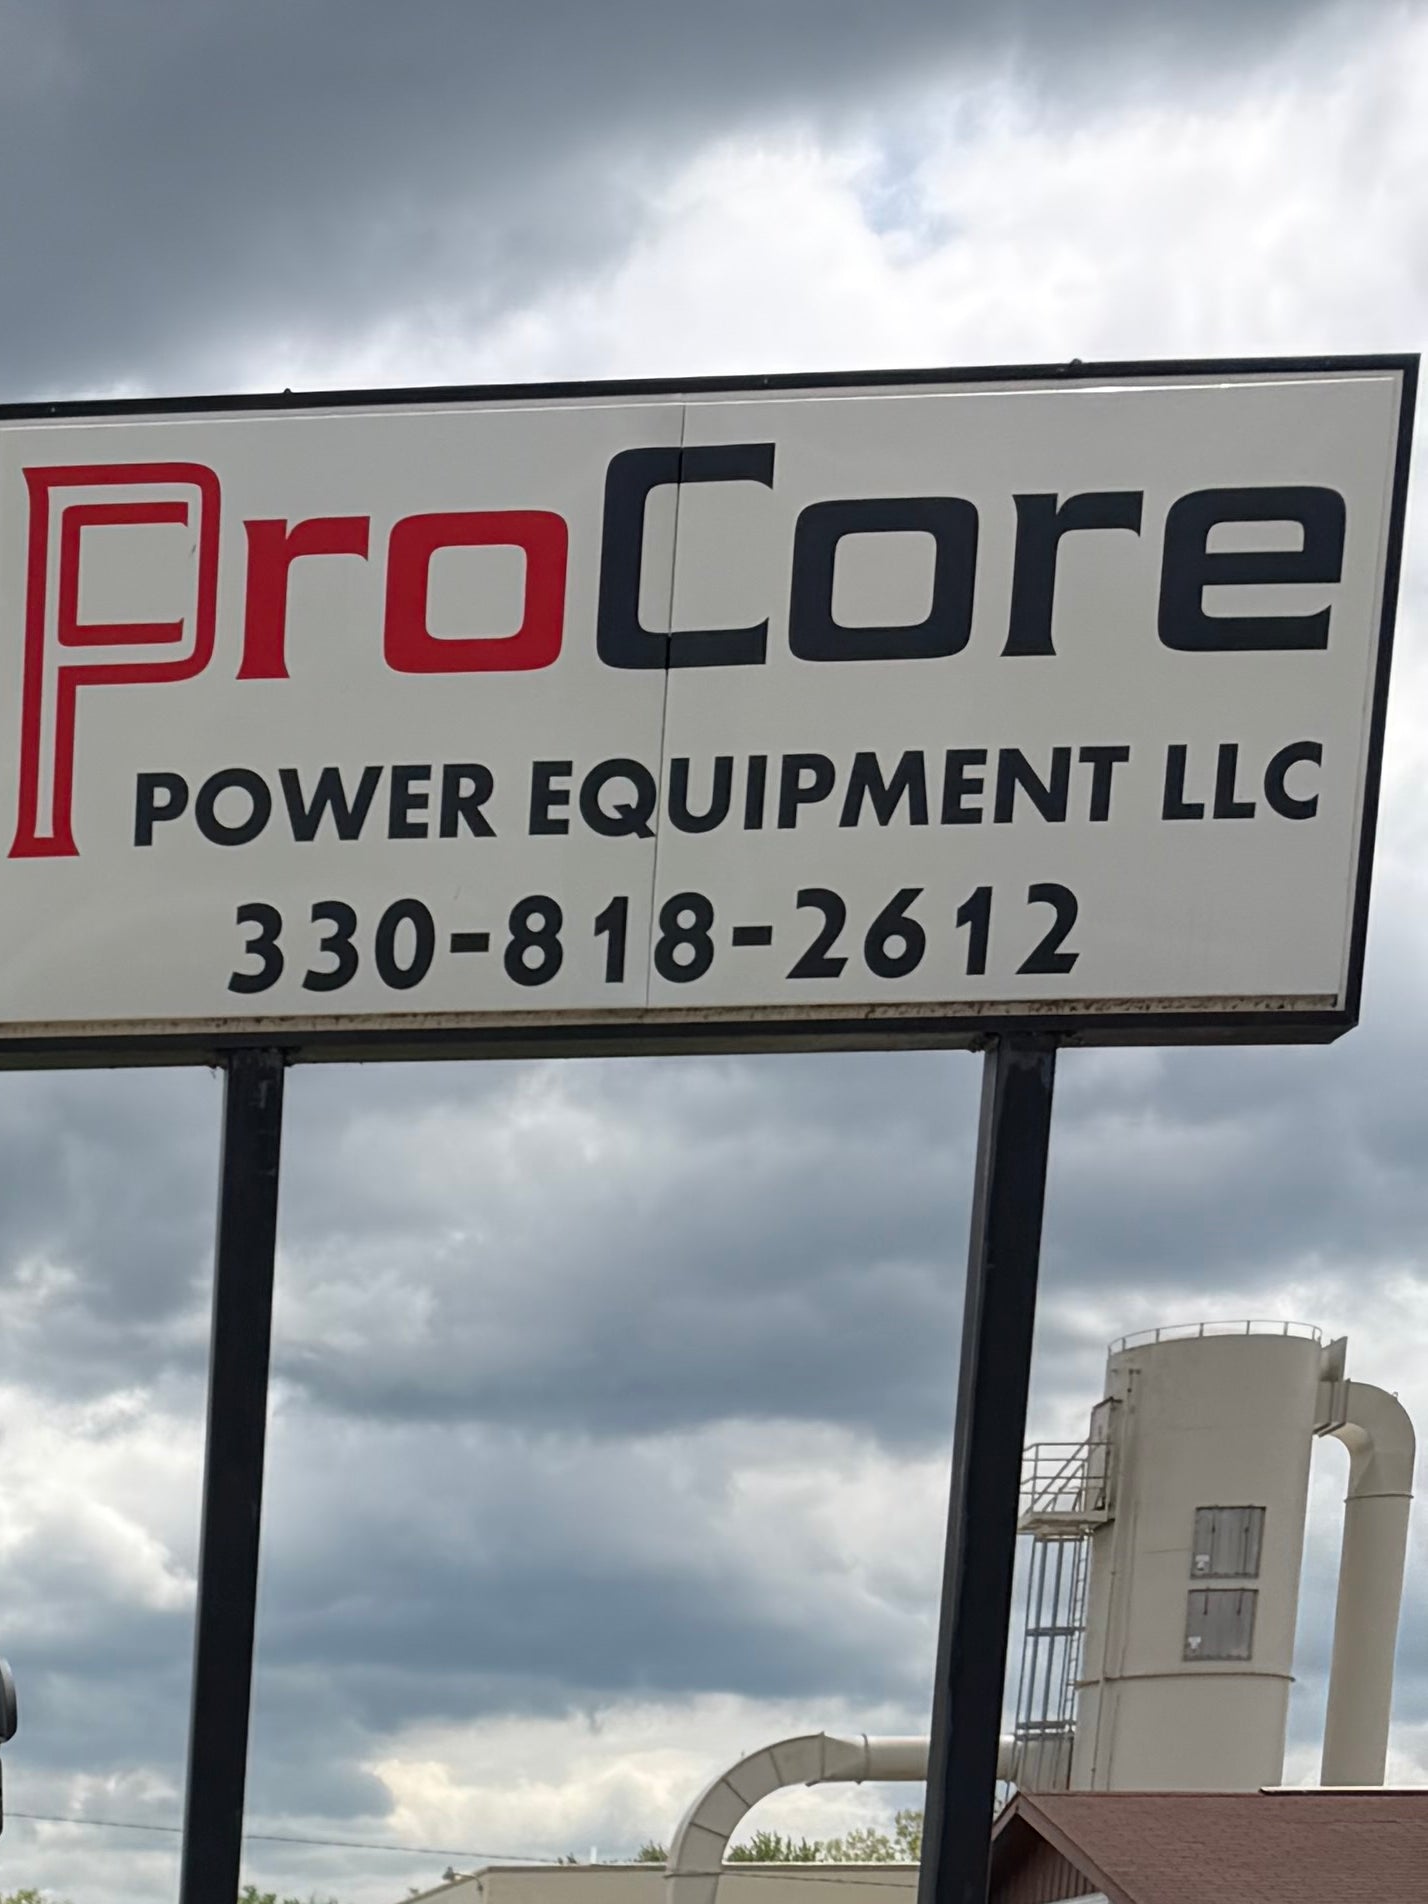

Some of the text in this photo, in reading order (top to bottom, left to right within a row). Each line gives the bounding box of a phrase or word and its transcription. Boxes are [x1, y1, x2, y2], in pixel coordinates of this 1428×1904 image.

[6, 442, 1347, 859] ProCore
[133, 740, 1323, 847] POWER EQUIPMENT LLC
[227, 882, 1080, 995] 330-818-2612
